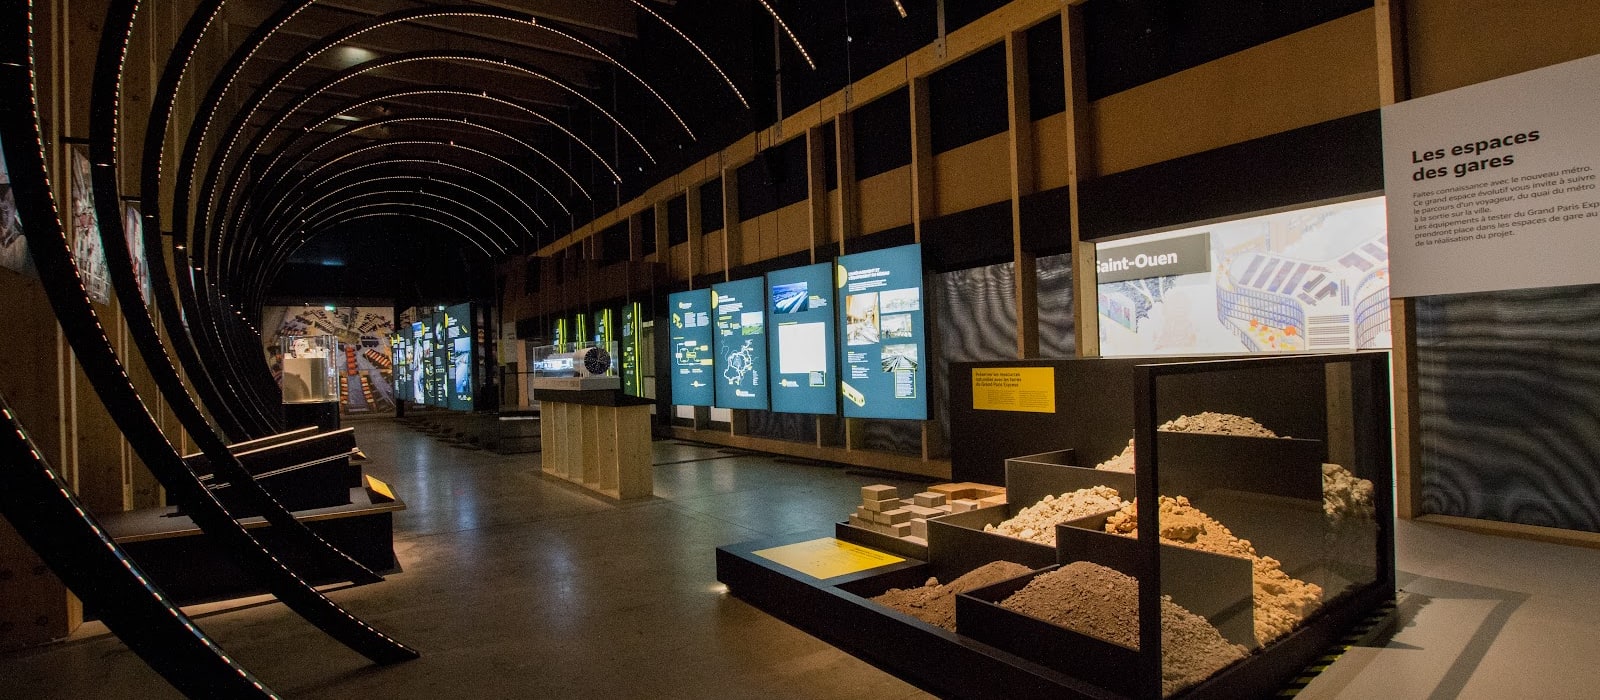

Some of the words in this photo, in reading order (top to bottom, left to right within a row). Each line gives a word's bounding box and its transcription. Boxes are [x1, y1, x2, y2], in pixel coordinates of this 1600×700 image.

[1412, 148, 1445, 164] Les
[1450, 130, 1540, 156] espaces
[1412, 166, 1448, 182] des
[1454, 154, 1514, 178] gares
[1413, 190, 1434, 198] Faites
[1436, 182, 1488, 194] connaissance
[1520, 171, 1559, 180] nouveau
[1562, 166, 1592, 175] métro.
[1422, 204, 1454, 214] parcours
[1476, 195, 1515, 204] voyageur,
[1530, 189, 1550, 198] quai
[1566, 183, 1596, 192] métro
[1424, 196, 1446, 206] grand
[1448, 192, 1476, 201] espace
[1478, 186, 1508, 196] évolutif
[1532, 180, 1556, 188] invite
[1568, 174, 1596, 184] suivre
[1414, 229, 1452, 239] prendront
[1454, 226, 1474, 236] place
[1512, 217, 1546, 227] espaces
[1562, 213, 1584, 222] gare
[1428, 212, 1450, 220] sortie
[1428, 217, 1480, 228] équipements
[1527, 206, 1554, 216] Grand
[1557, 204, 1580, 212] Paris
[1434, 235, 1474, 244] réalisation
[1488, 230, 1515, 239] projet.
